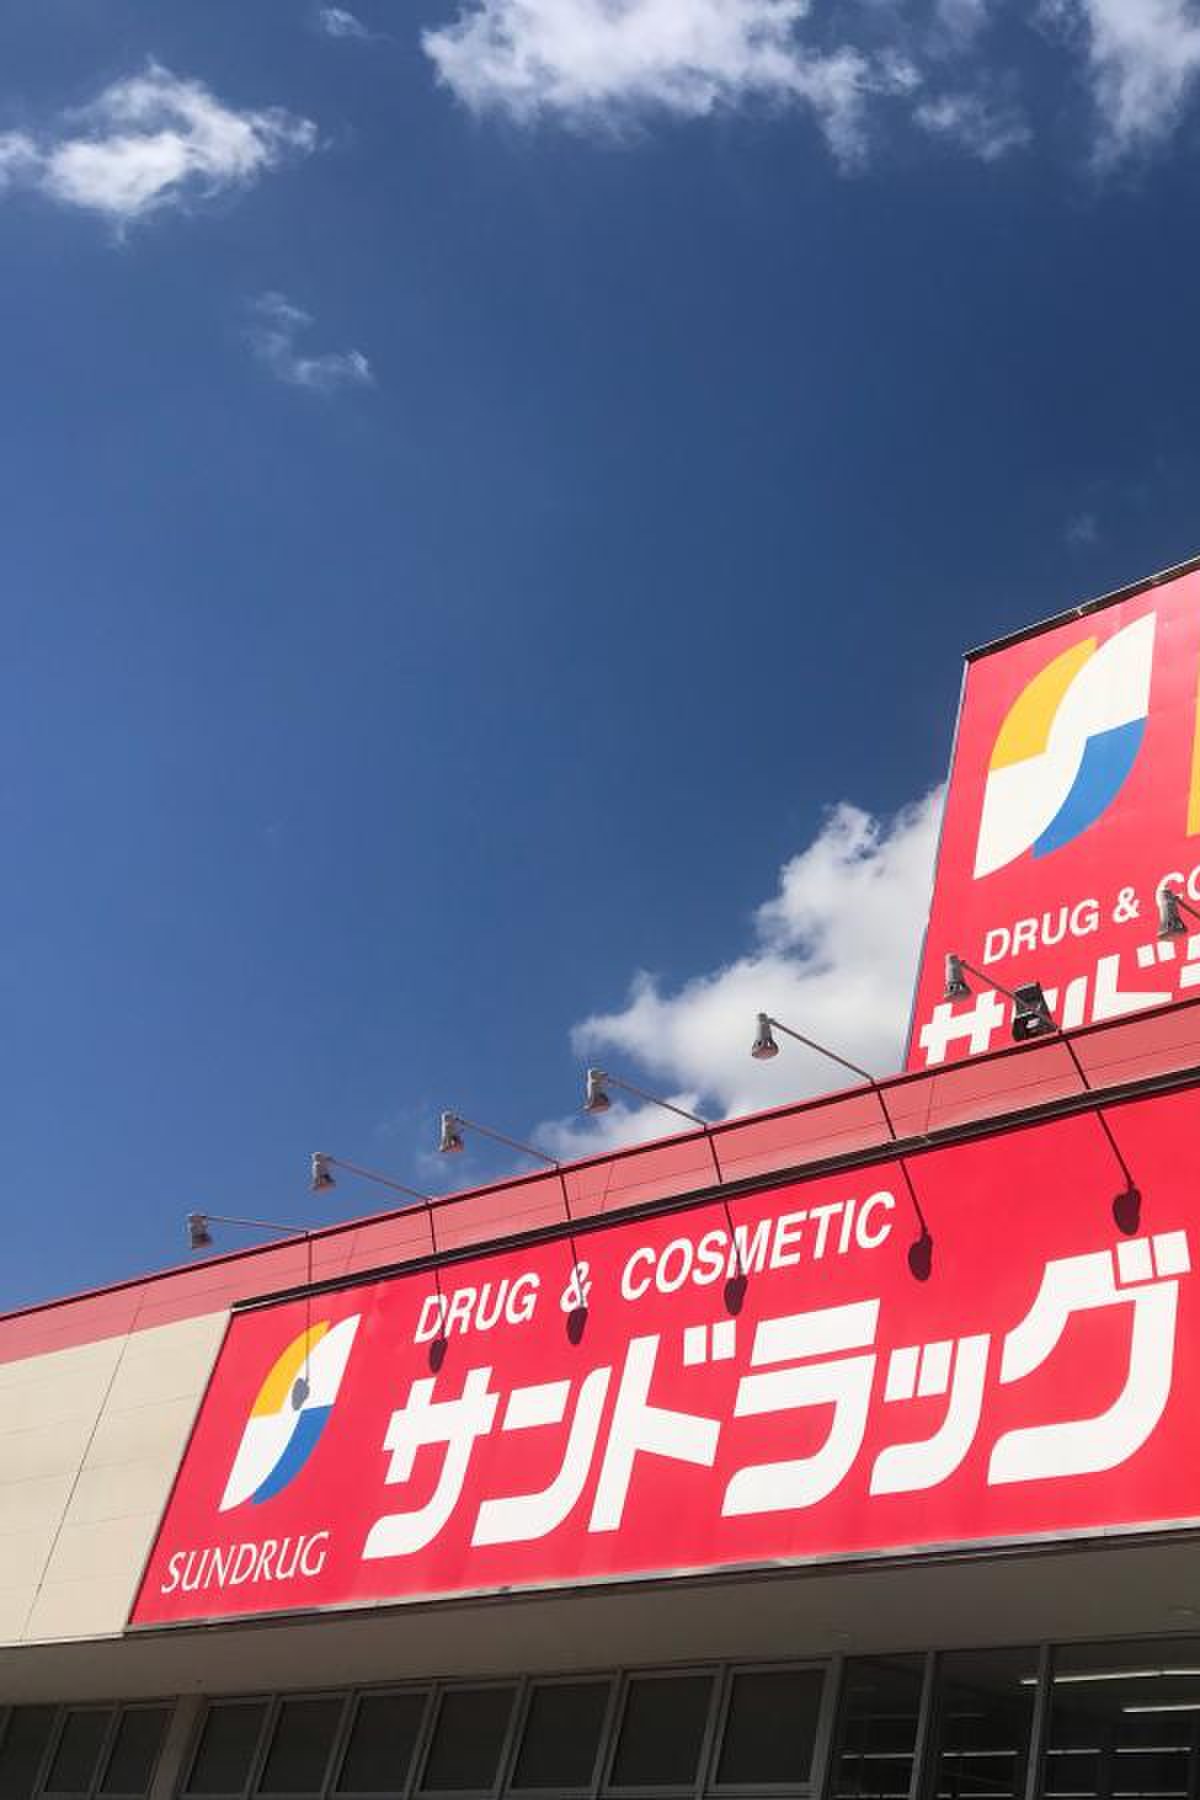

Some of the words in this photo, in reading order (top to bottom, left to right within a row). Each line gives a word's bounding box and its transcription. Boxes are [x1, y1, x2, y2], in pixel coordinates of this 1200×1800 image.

[983, 898, 1100, 965] DRUG
[1113, 886, 1140, 924] &
[414, 1272, 540, 1344] DRUG
[560, 1262, 592, 1314] &
[620, 1191, 896, 1301] COSMETIC
[361, 1230, 1191, 1559] サンドラッグ
[161, 1531, 328, 1594] SUNDRUG
